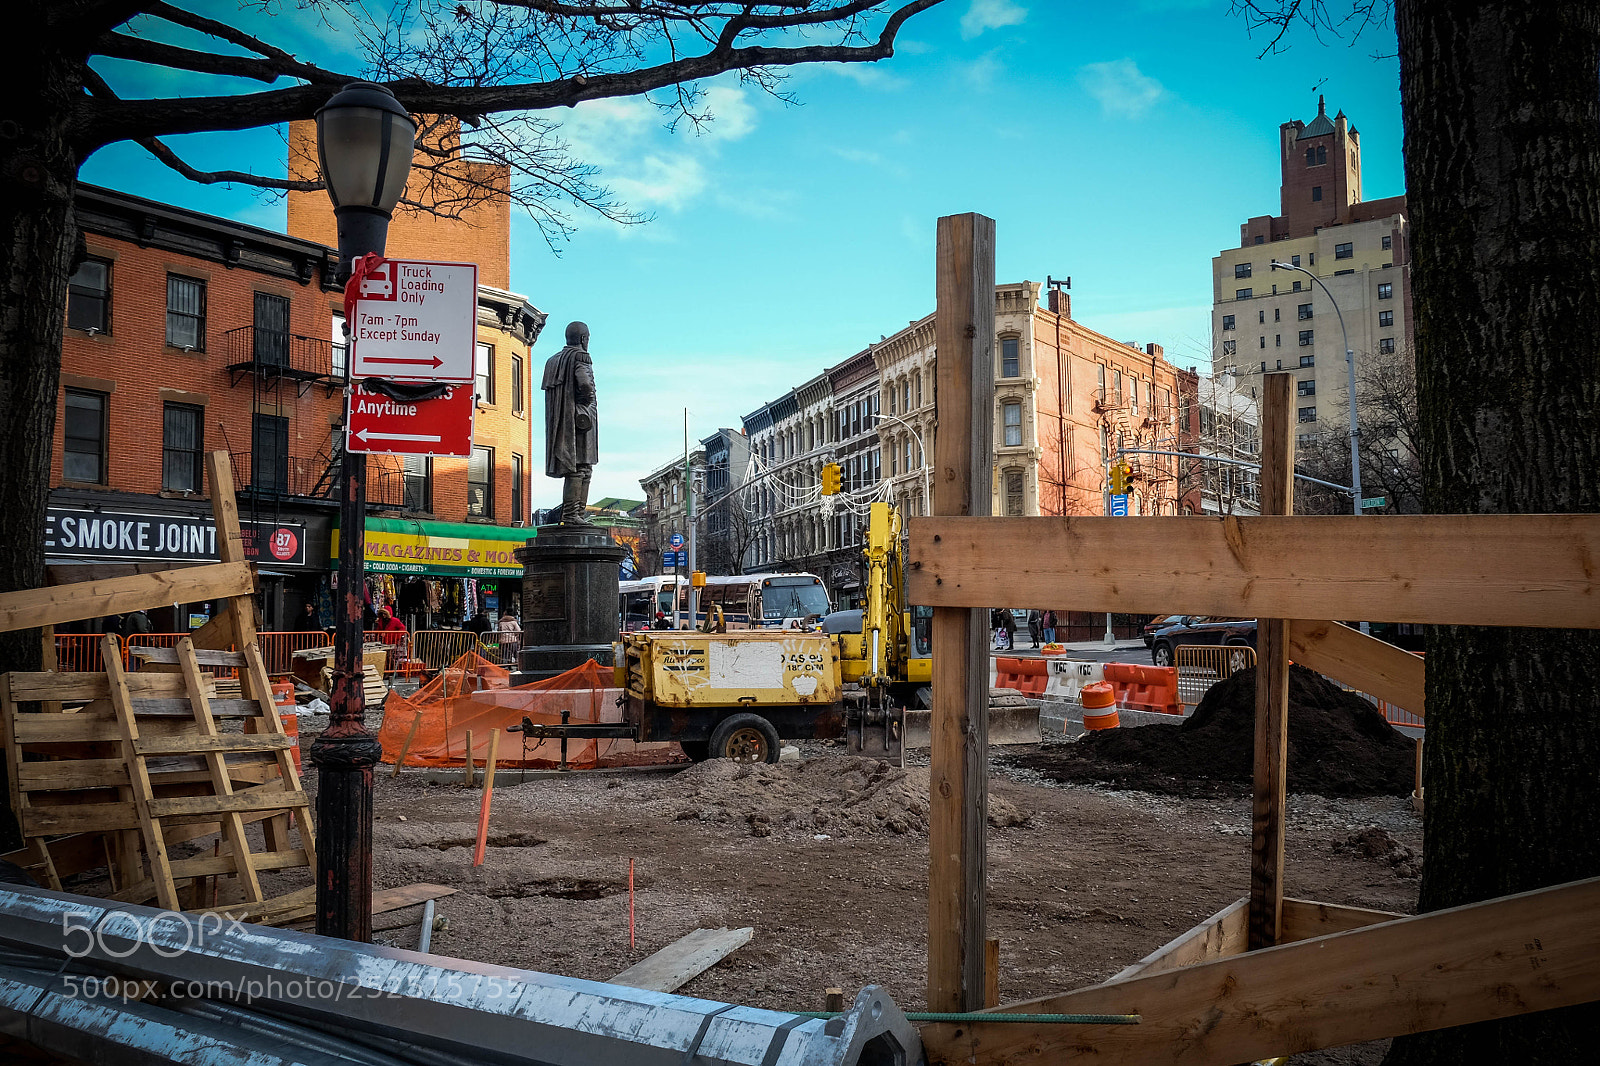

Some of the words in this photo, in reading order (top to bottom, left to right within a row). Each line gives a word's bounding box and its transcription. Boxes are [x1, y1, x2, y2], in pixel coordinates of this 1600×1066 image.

[402, 266, 432, 278] Truck
[401, 278, 444, 294] Loading
[401, 292, 425, 306] Only
[360, 314, 384, 326] 7am
[394, 314, 418, 327] 7pm
[360, 328, 397, 342] Except
[401, 330, 440, 344] Sunday
[357, 400, 417, 418] Anytime
[60, 516, 150, 551] SMOKE
[155, 523, 216, 554] JOINT
[276, 534, 290, 546] 87
[366, 542, 463, 562] MAGAZINES
[467, 549, 482, 563] &
